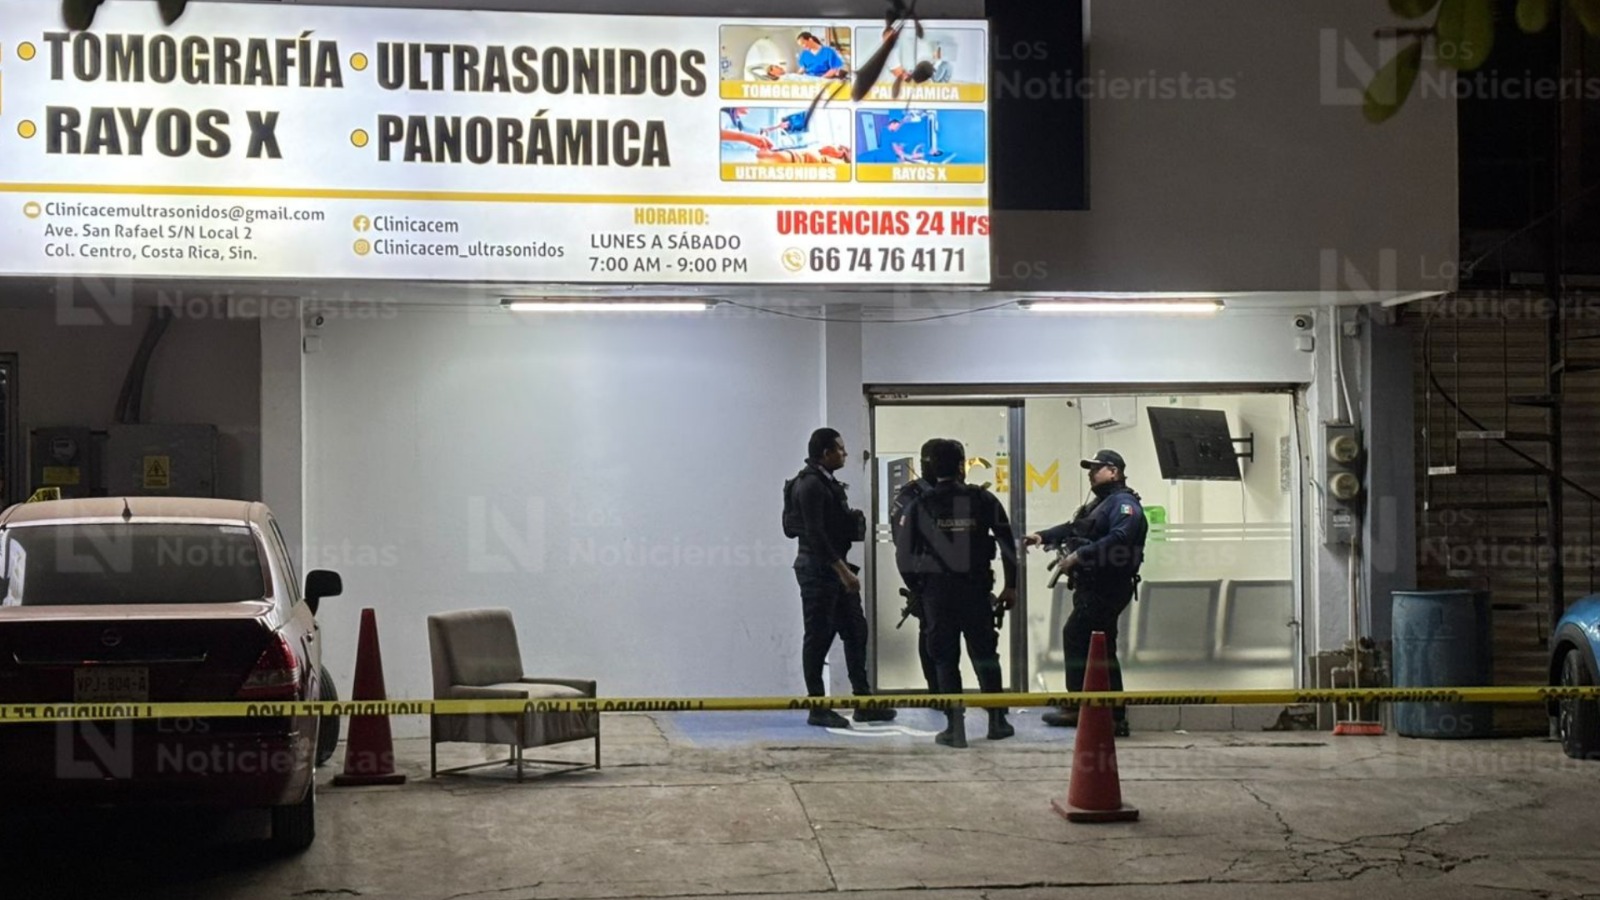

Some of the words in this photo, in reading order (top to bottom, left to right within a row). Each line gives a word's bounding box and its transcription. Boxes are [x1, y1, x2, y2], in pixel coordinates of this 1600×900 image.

[43, 30, 344, 88] TOMOGRAFÍA
[377, 42, 707, 97] ULTRASONIDOS
[742, 84, 830, 98] TOMOGRAF
[46, 106, 231, 158] RAYOS
[246, 110, 282, 159] X
[378, 109, 671, 167] PANORÁMICA
[735, 166, 837, 181] ULTRASONIDOS
[892, 166, 933, 181] RAYOS
[937, 166, 947, 181] X
[374, 215, 459, 233] Clinicacem
[634, 207, 709, 226] HORARIO:
[776, 210, 910, 236] URGENCIAS
[916, 211, 944, 236] 24
[951, 211, 990, 236] Hrs
[45, 223, 78, 237] Ave.
[83, 224, 110, 238] San
[115, 224, 164, 239] Rafael
[168, 225, 194, 239] S/N
[200, 226, 239, 240] Local
[244, 227, 252, 240] 2
[591, 234, 647, 250] LUNES
[651, 235, 664, 250] A
[668, 231, 742, 251] SÁBADO
[45, 243, 74, 257] Col.
[80, 244, 137, 260] Centro,
[141, 245, 184, 259] Costa
[189, 245, 225, 261] Rica,
[229, 246, 258, 260] Sin.
[374, 239, 565, 259] Clinicacem_ultrasonidos
[589, 256, 628, 272] 7:00
[633, 257, 661, 273] AM
[677, 257, 717, 273] 9:00
[722, 258, 748, 273] PM
[809, 247, 840, 272] 66
[848, 248, 872, 272] 74
[879, 248, 905, 272] 76
[912, 248, 936, 272] 41
[942, 248, 965, 272] 71
